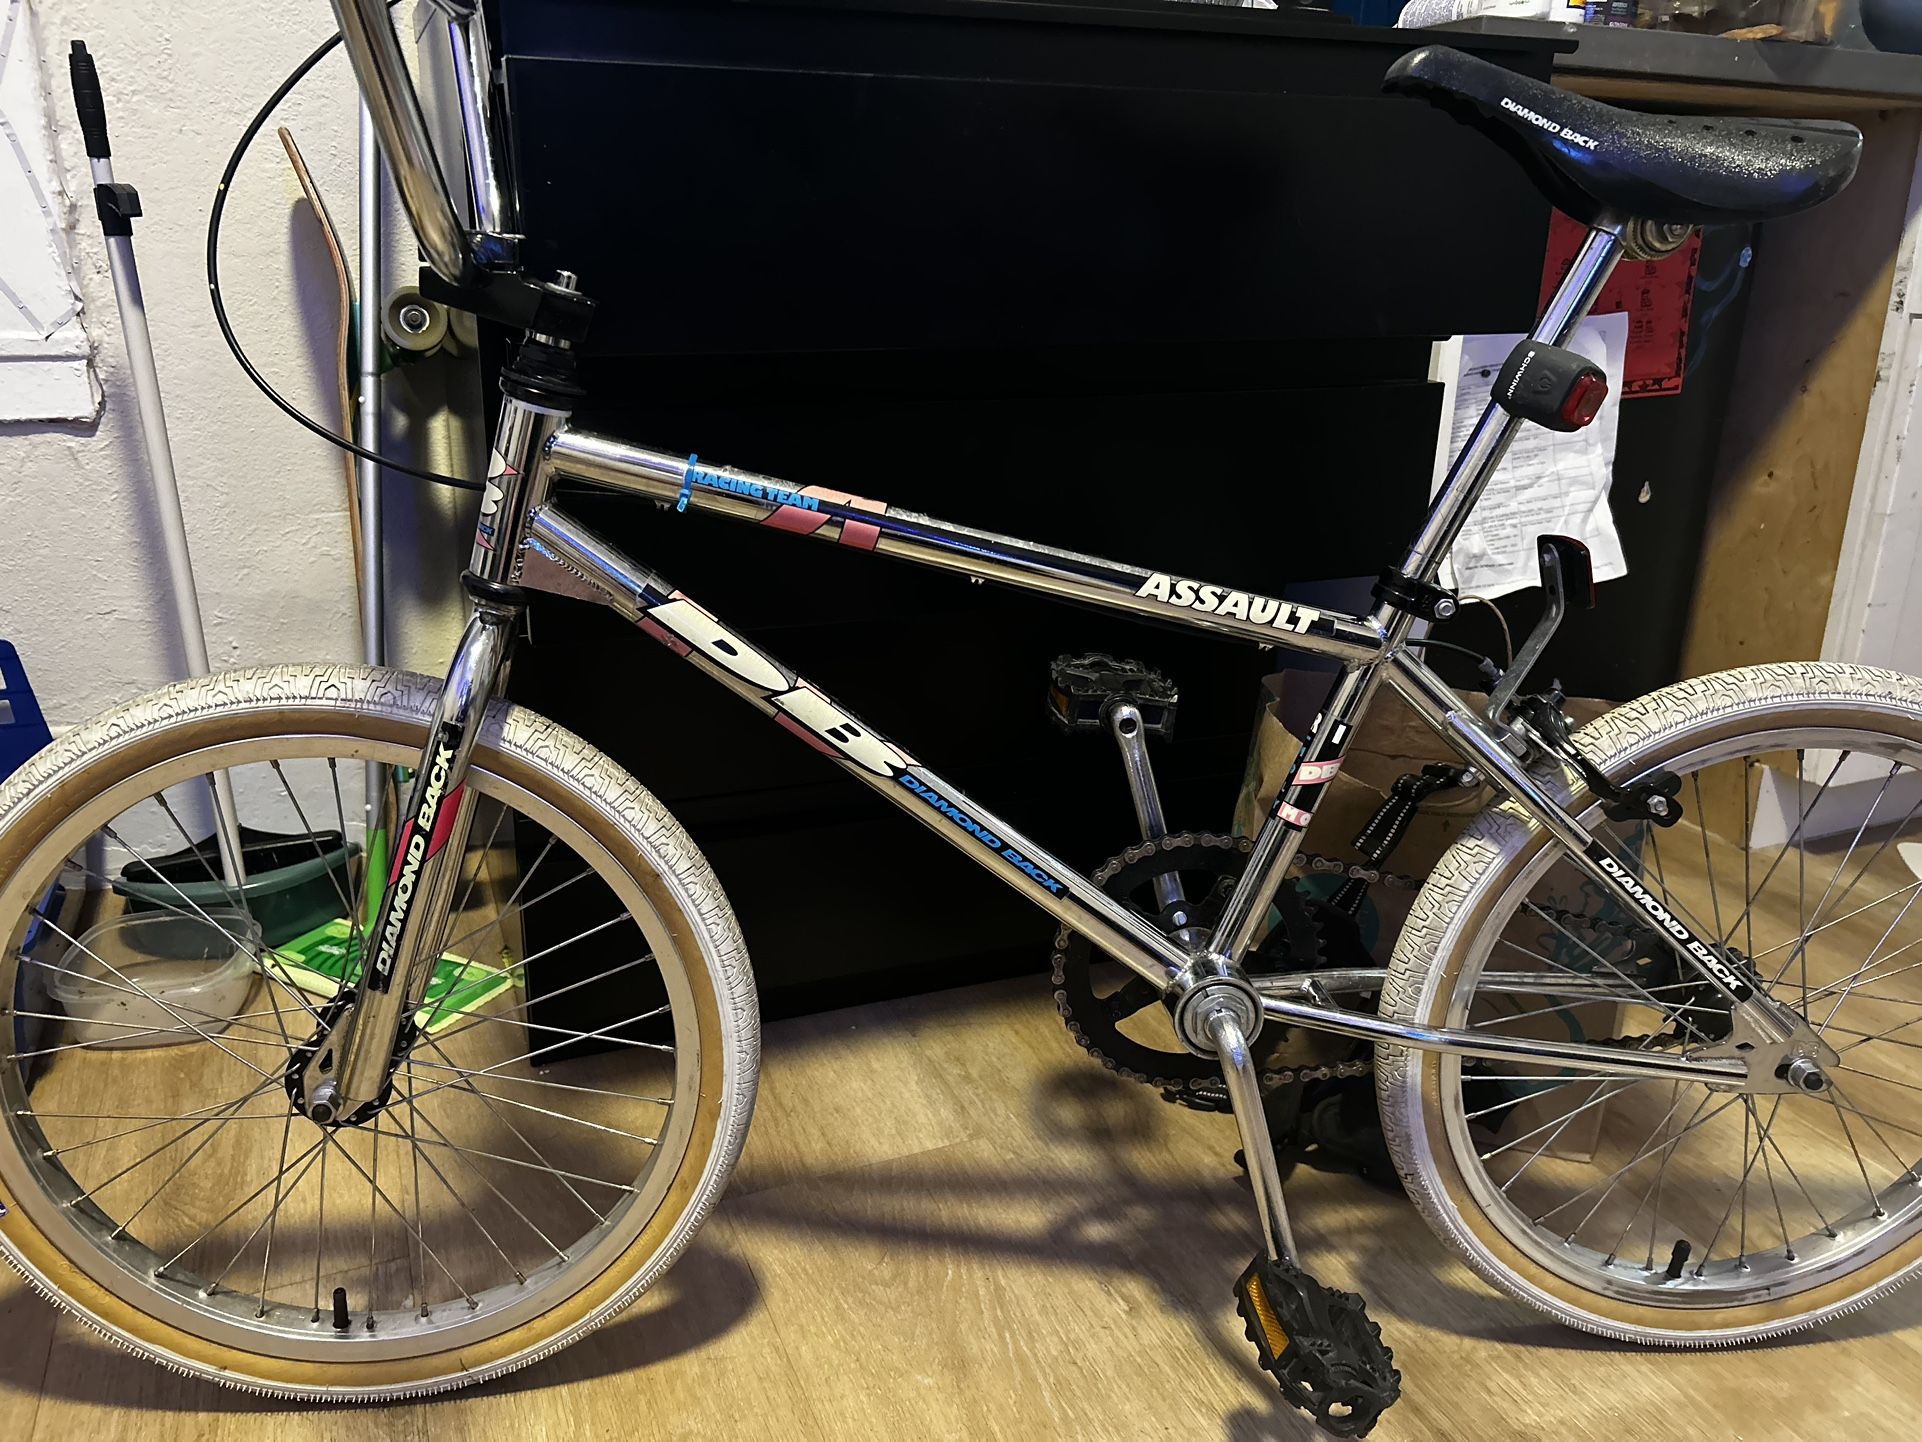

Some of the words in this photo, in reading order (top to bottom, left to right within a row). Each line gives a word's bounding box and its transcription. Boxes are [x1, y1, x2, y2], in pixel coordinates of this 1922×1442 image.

[1501, 97, 1560, 133] DIAMOND
[1560, 127, 1599, 150] BACK
[1507, 350, 1536, 398] SCHWINN
[692, 471, 763, 498] RACING
[764, 489, 820, 512] TEAM
[1135, 572, 1321, 635] ASSAULT
[647, 599, 908, 777] DB
[376, 834, 426, 976] DIAMOND
[418, 742, 454, 832] BACK
[899, 774, 1002, 849] DIAMOND
[1001, 848, 1063, 893] BACK
[1598, 857, 1690, 940] DIAMOND
[1686, 940, 1744, 991] BACK
